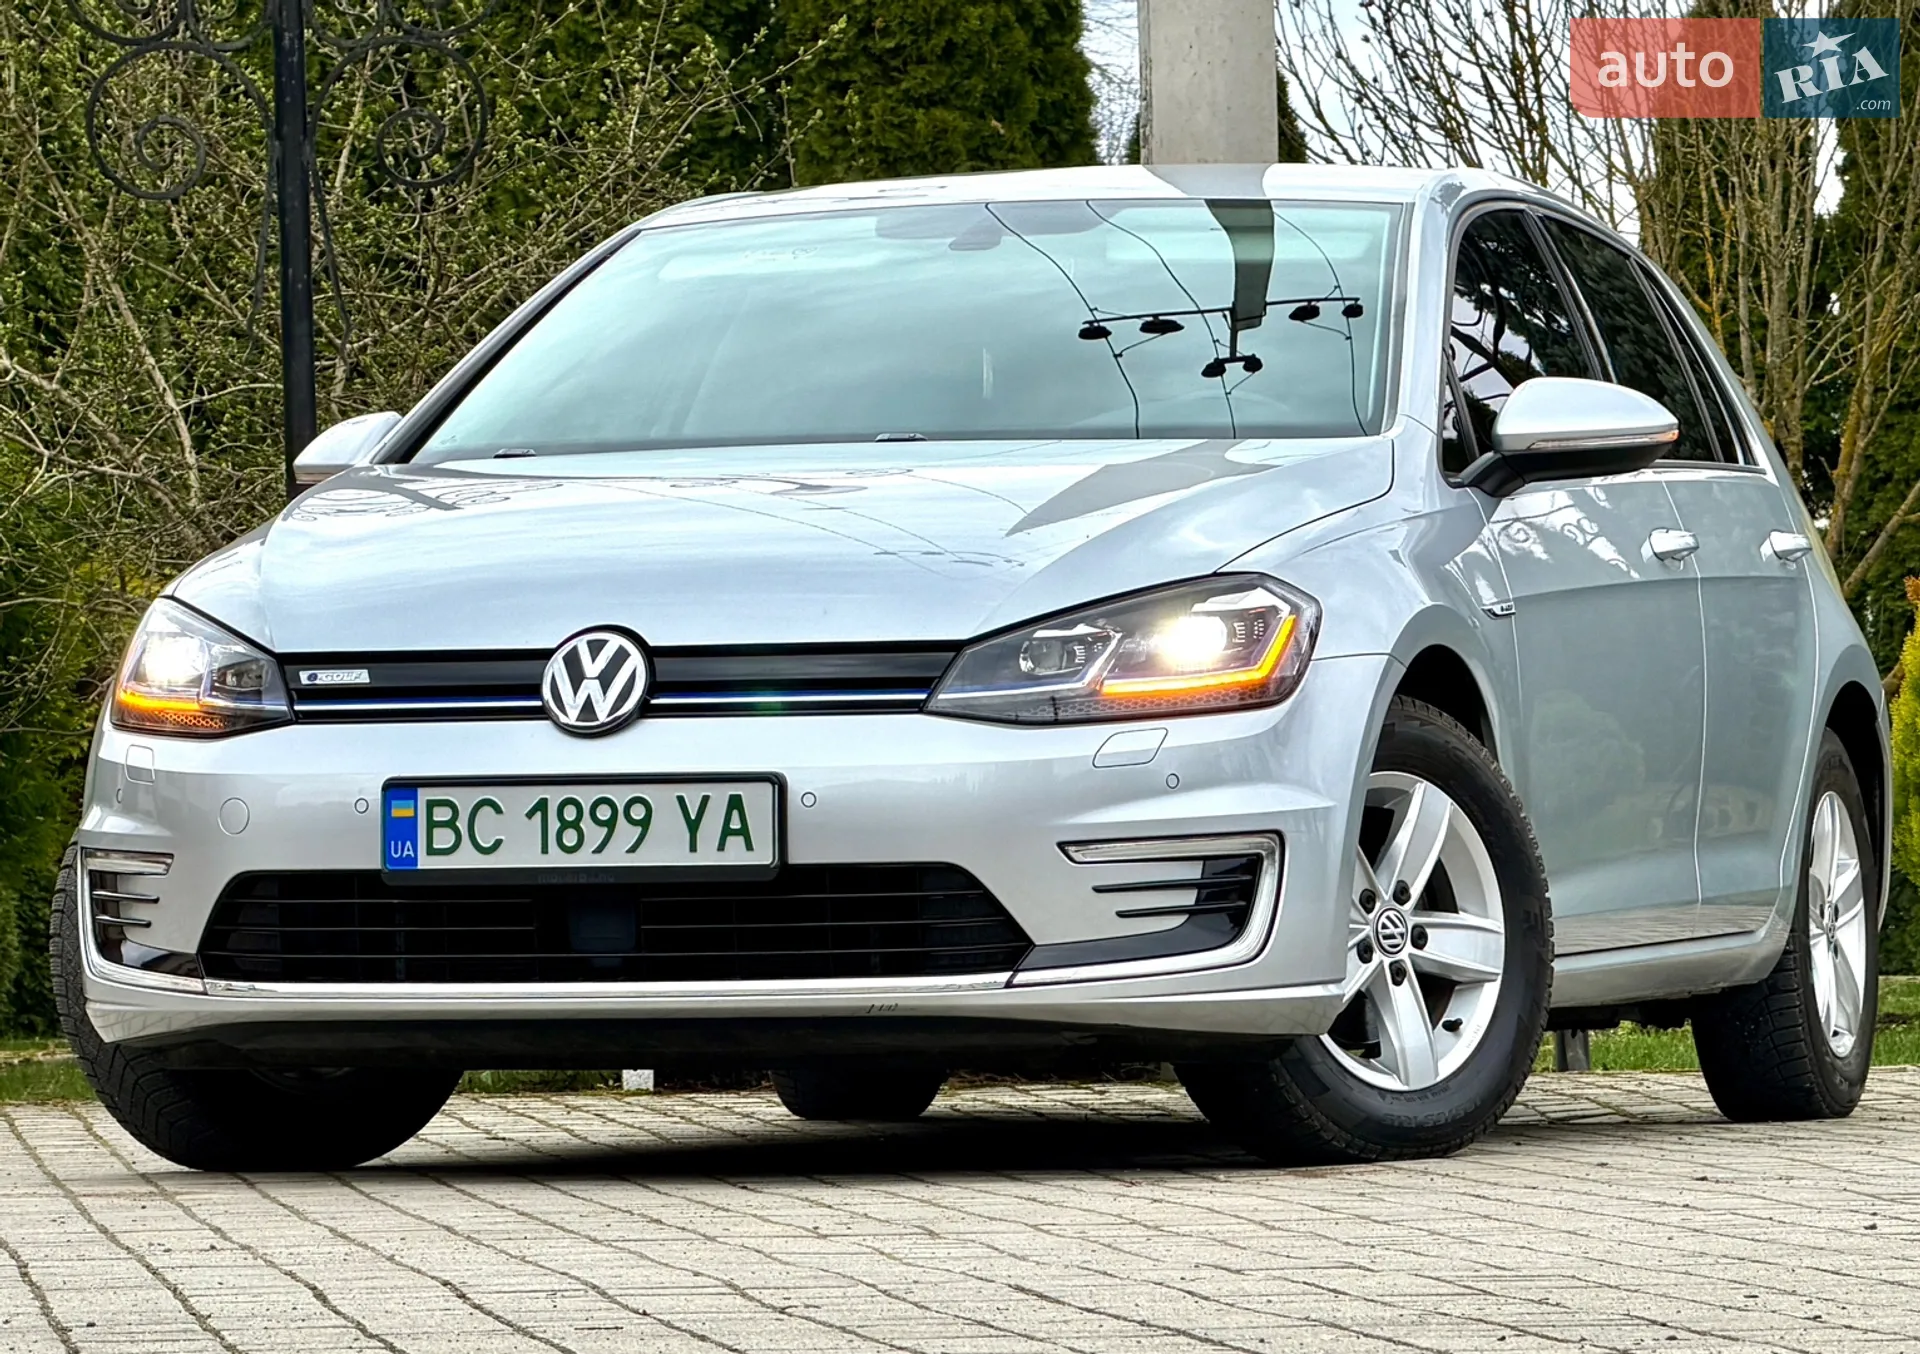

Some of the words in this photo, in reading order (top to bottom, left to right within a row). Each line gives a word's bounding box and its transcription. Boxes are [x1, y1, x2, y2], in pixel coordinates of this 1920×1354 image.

[542, 632, 646, 727] VW
[391, 840, 415, 858] UA
[425, 797, 504, 856] BC
[524, 793, 654, 855] 1899
[675, 792, 755, 853] YA
